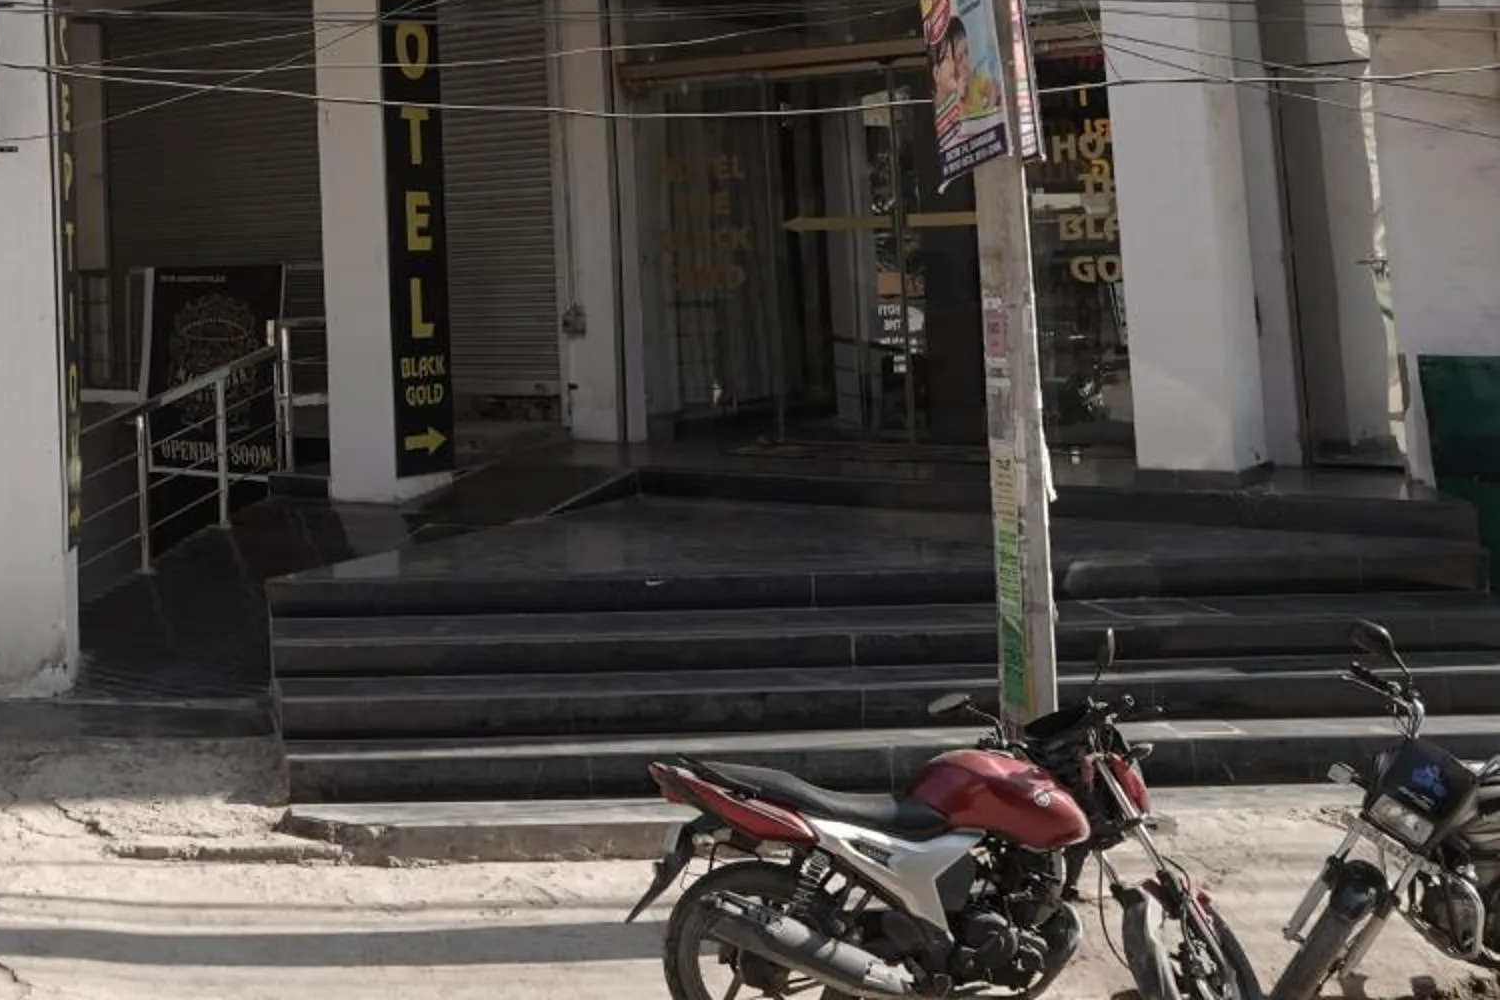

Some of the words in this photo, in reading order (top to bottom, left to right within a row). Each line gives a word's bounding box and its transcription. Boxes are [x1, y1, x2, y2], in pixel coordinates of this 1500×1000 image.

[400, 355, 446, 378] BLACK
[405, 379, 444, 406] GOLD
[161, 439, 222, 464] OPENIN
